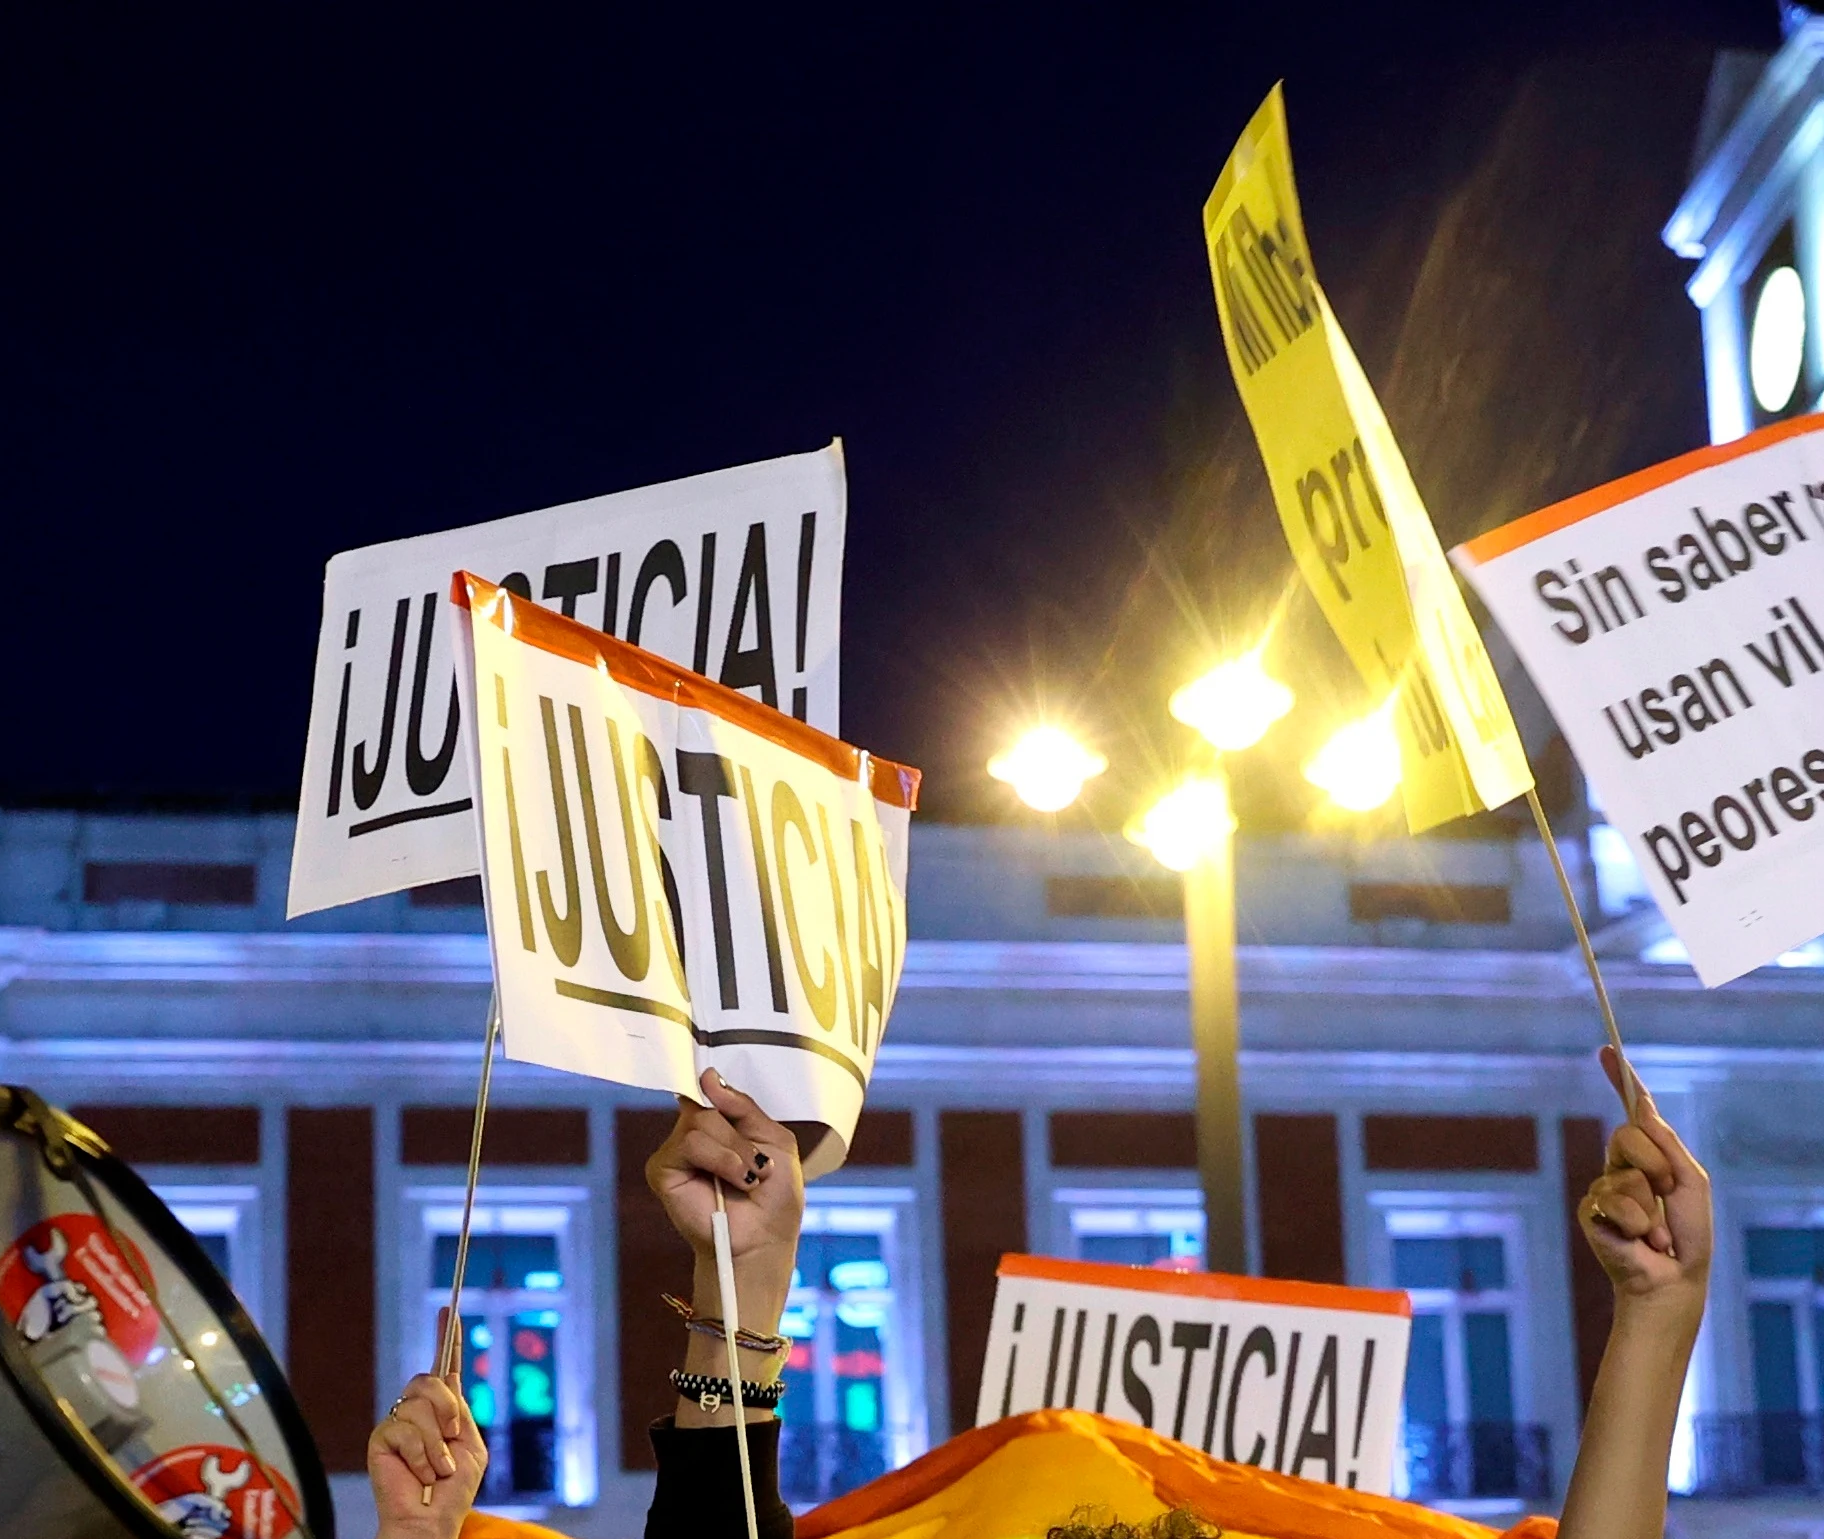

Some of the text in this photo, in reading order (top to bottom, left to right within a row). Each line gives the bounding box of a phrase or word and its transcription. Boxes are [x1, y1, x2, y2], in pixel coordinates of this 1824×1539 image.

[1531, 557, 1649, 646] Sin
[1646, 490, 1799, 605] saber
[1603, 656, 1759, 761] usan
